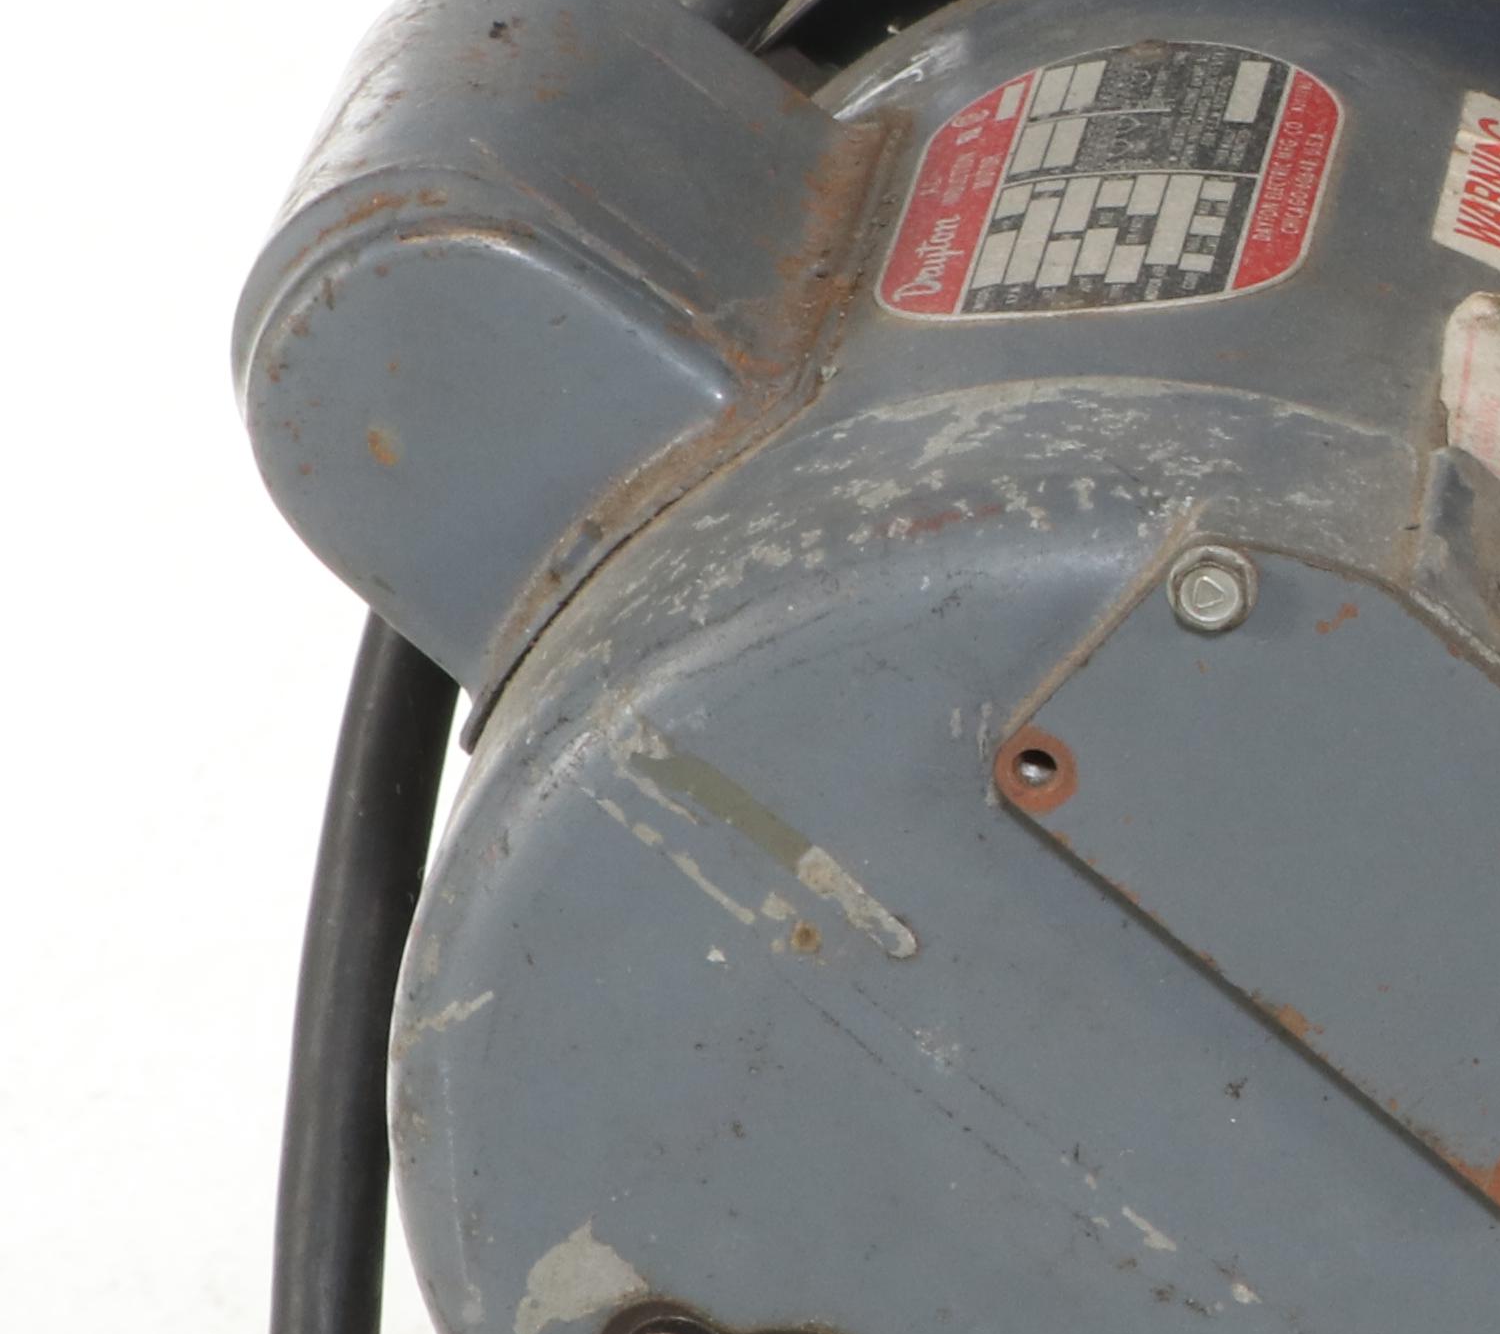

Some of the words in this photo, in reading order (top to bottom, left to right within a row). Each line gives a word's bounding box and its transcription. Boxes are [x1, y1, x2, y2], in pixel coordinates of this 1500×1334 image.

[1261, 160, 1293, 200] ELECTRIC
[1249, 201, 1281, 241] DAYTON
[893, 214, 964, 304] Dayton
